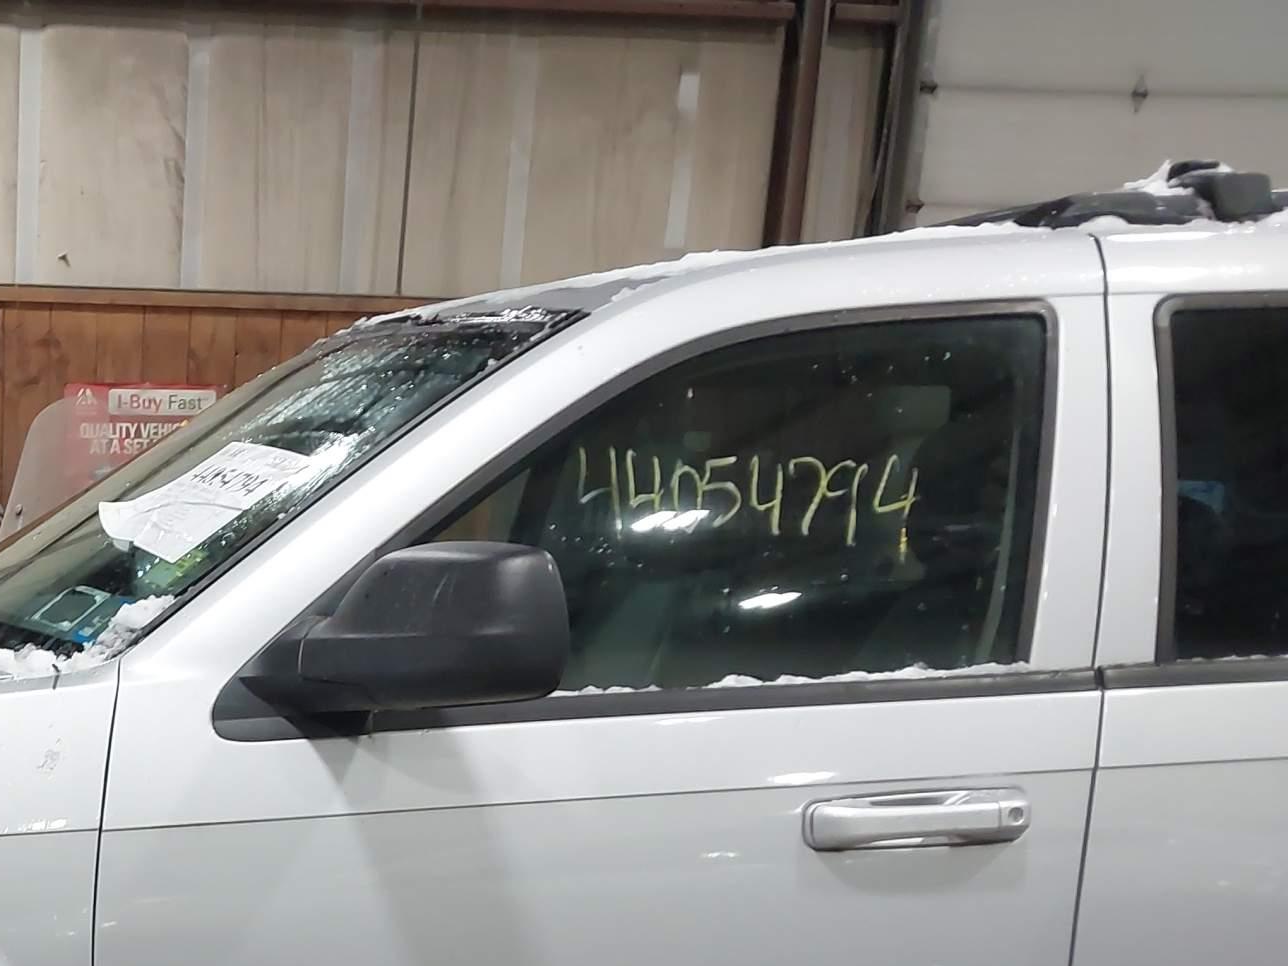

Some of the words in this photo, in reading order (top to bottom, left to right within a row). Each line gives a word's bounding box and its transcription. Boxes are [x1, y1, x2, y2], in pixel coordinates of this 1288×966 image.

[117, 394, 162, 412] I-Buy
[79, 422, 138, 439] QUALITY
[579, 446, 920, 562] 44054794
